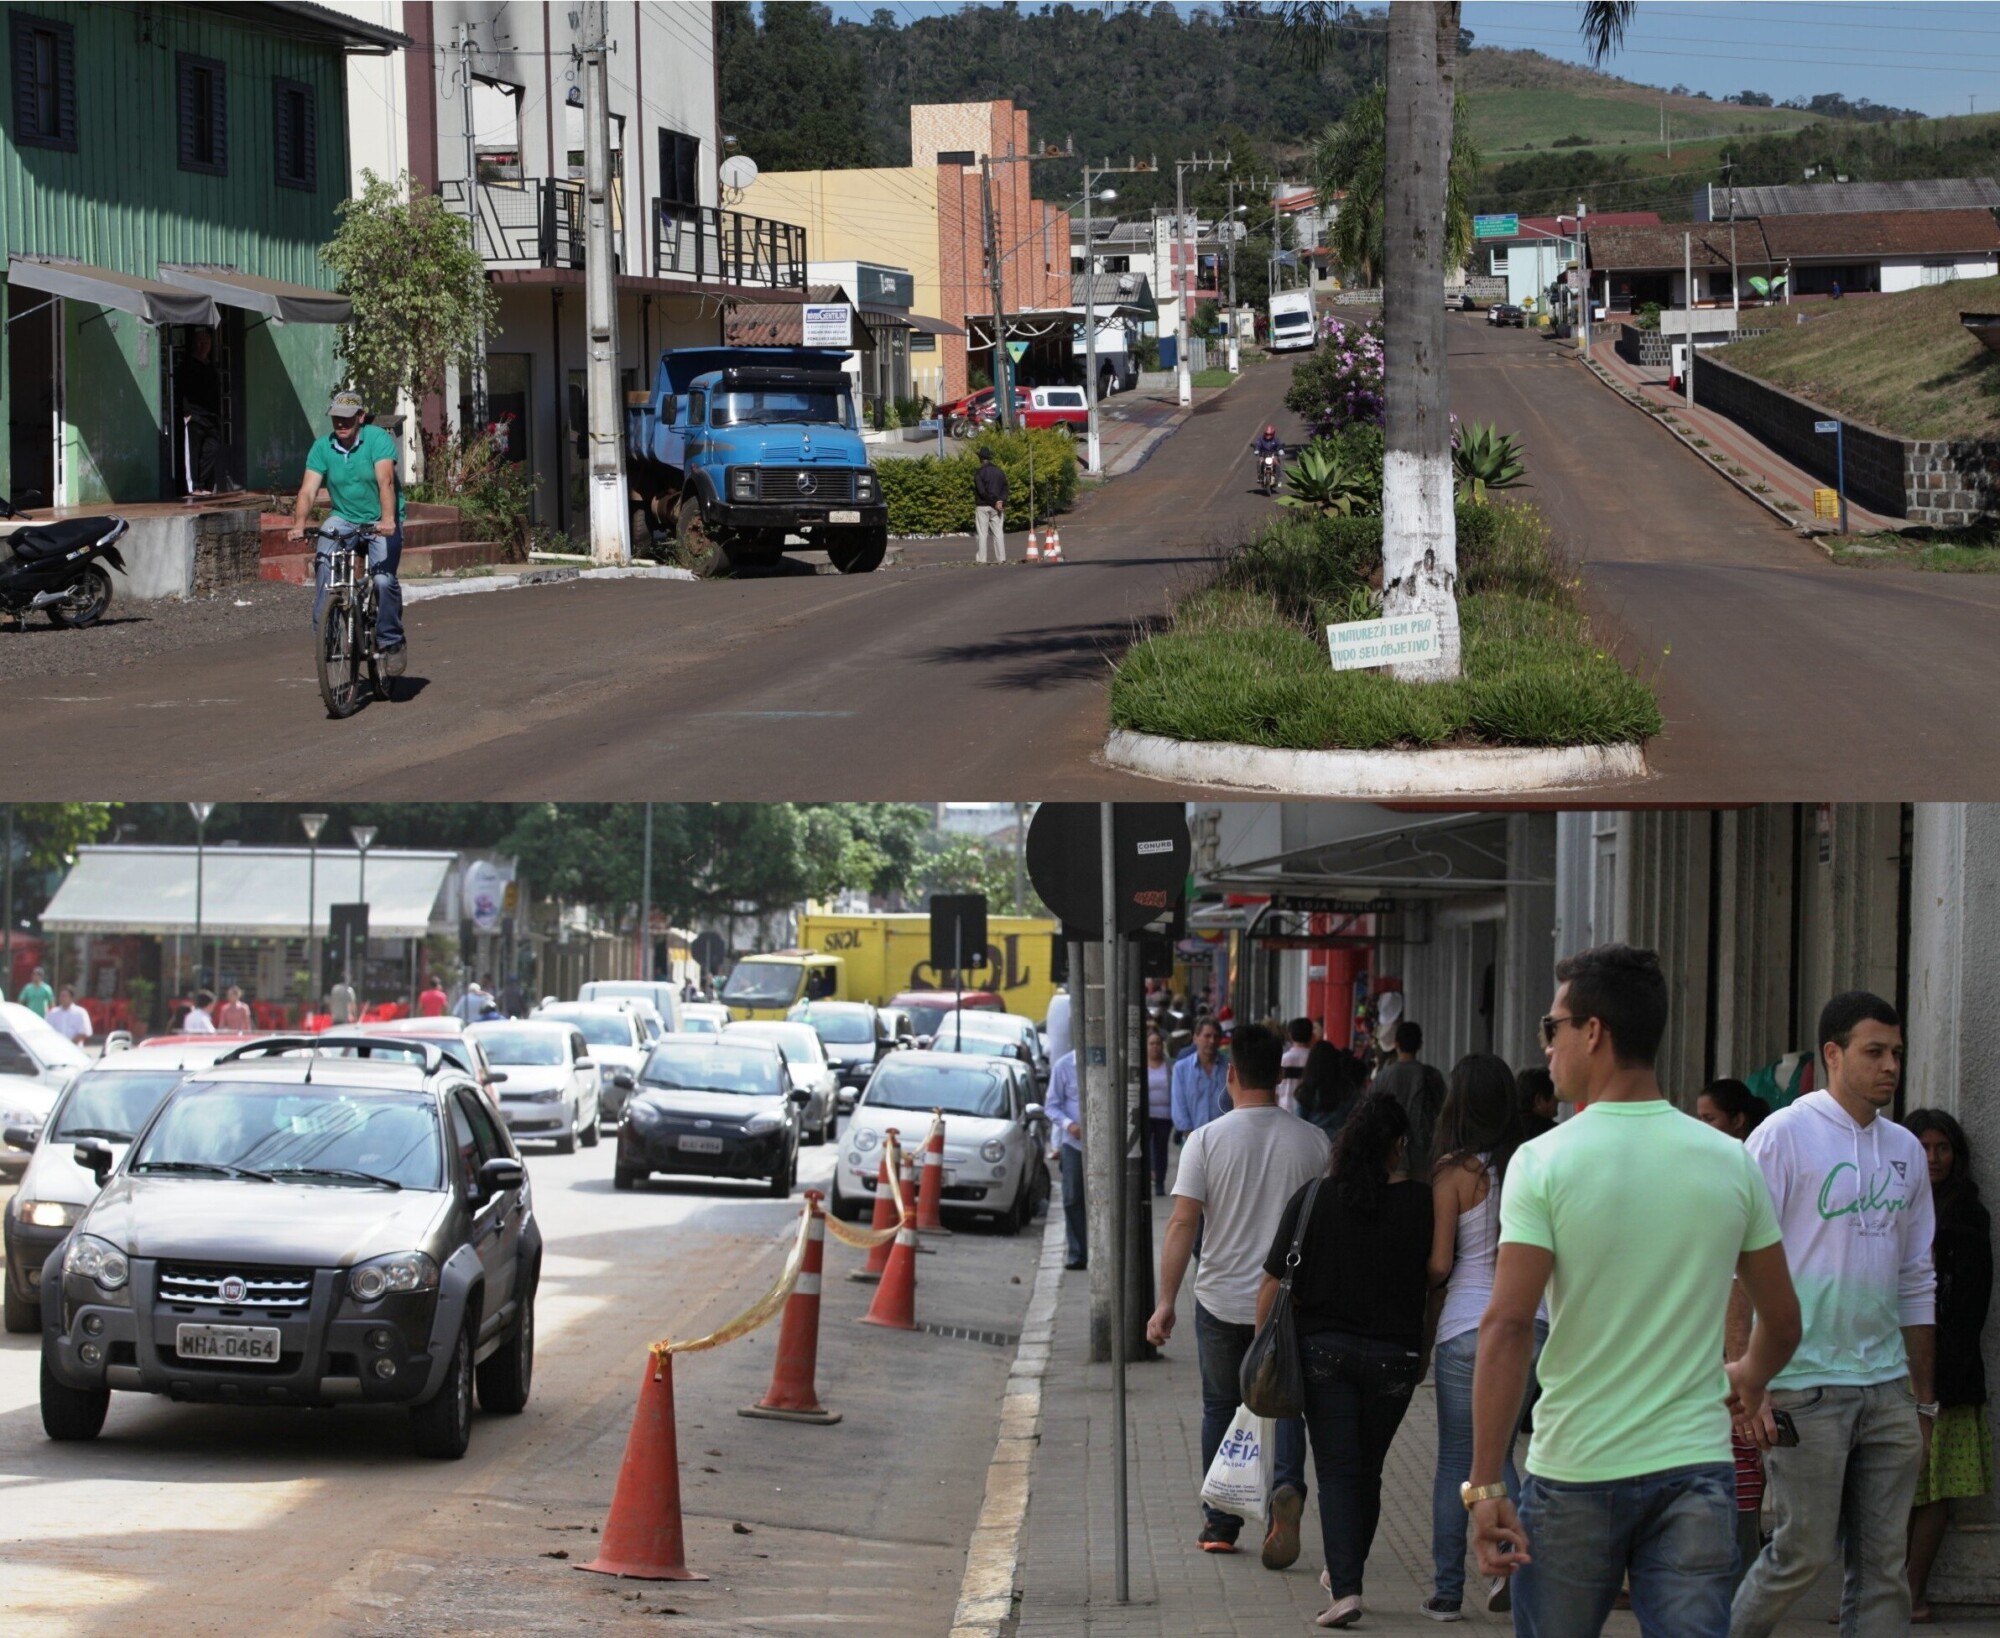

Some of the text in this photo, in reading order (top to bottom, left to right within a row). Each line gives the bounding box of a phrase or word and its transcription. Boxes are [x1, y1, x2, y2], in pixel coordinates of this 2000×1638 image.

[1330, 619, 1431, 644] A NATUREZA TEM PRA
[1332, 648, 1356, 662] TUDO
[1360, 645, 1379, 659] SEU
[1381, 639, 1430, 657] OBJETIVO
[1138, 841, 1172, 850] CONURB
[1298, 901, 1328, 910] LOJA
[824, 929, 861, 951] SKOL
[1817, 1161, 1912, 1221] Calvi
[226, 1284, 240, 1296] FIAT
[182, 1336, 274, 1357] MHA-0464
